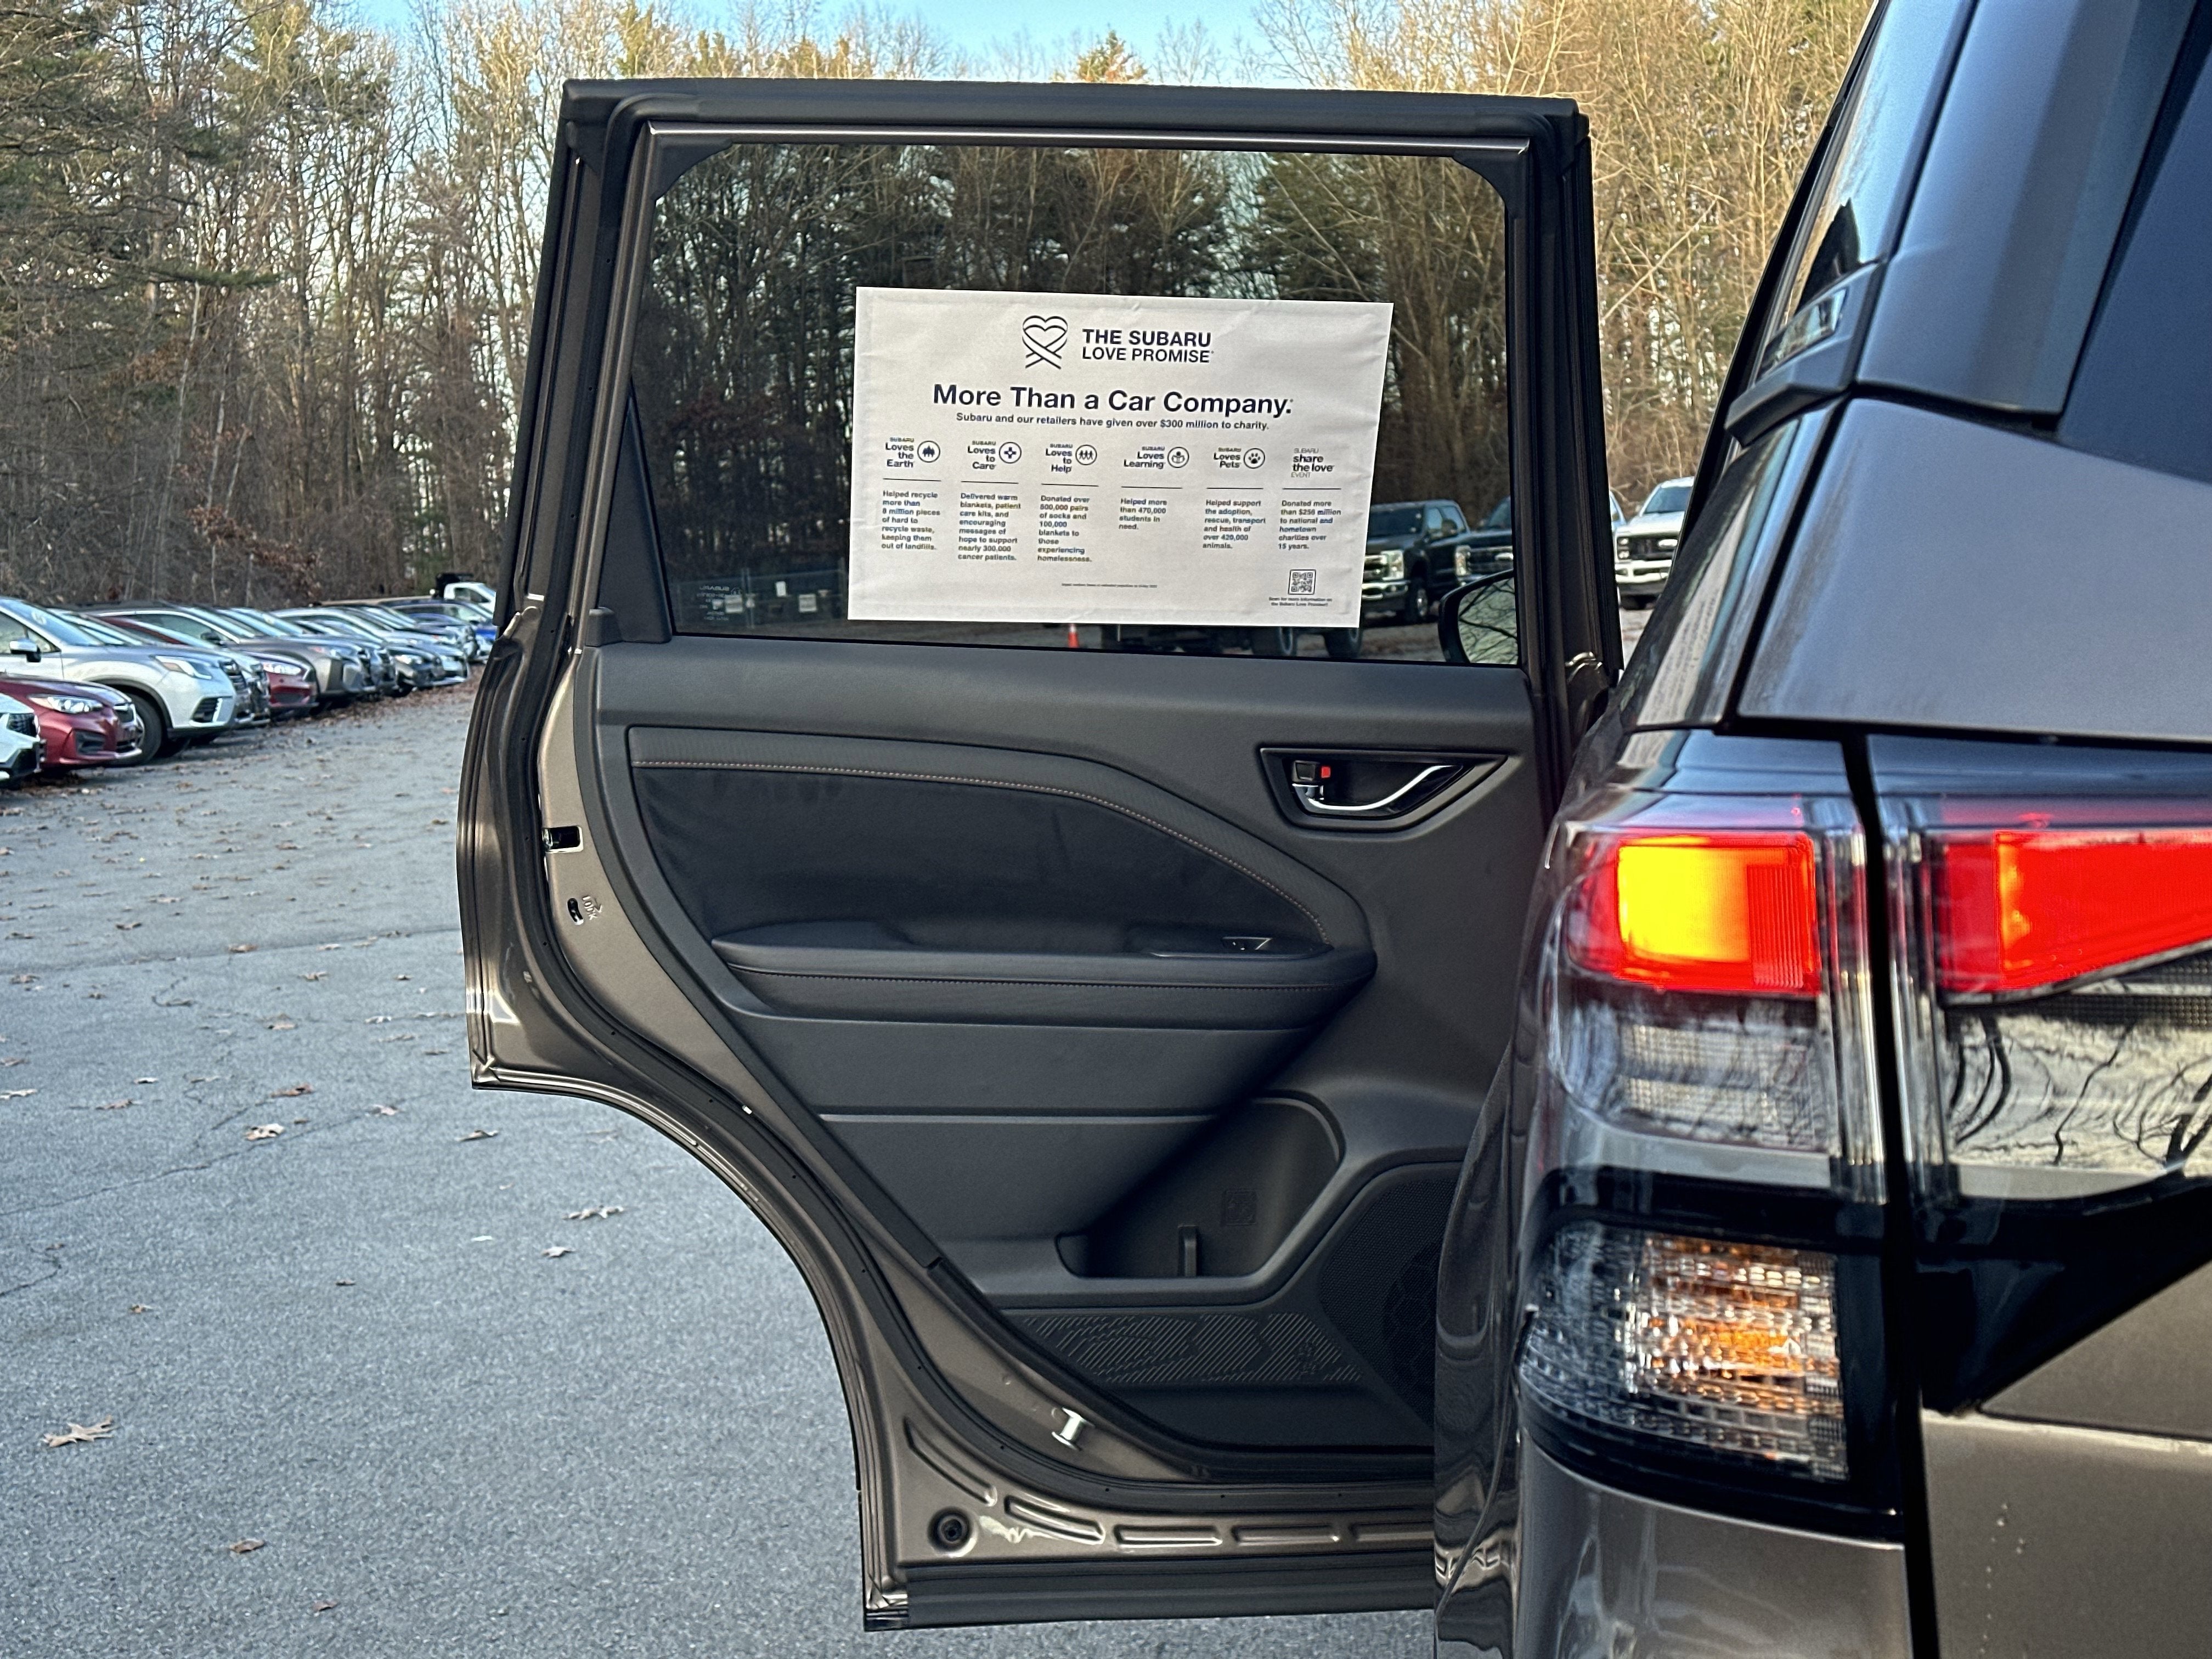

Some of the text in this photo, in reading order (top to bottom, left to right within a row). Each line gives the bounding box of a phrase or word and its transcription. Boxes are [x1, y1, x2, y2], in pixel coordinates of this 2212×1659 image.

[1083, 329, 1211, 347] THE SUBARU
[1083, 346, 1209, 363] LOVE PROMISE
[934, 384, 1291, 418] More Than a Car Company.
[957, 413, 992, 421] Subaru
[996, 414, 1014, 422] and
[1037, 416, 1076, 425] retailers
[1080, 417, 1103, 425] have
[1106, 418, 1132, 426] given
[1186, 420, 1218, 428] million
[1234, 421, 1269, 430] charity.
[885, 443, 914, 451] Loves
[967, 446, 995, 454] Loves
[1293, 454, 1324, 462] share
[887, 459, 913, 468] Earth
[1124, 460, 1164, 469] Learning
[1293, 463, 1333, 472] the love
[1051, 465, 1071, 473] Help
[960, 501, 993, 509] blankets,
